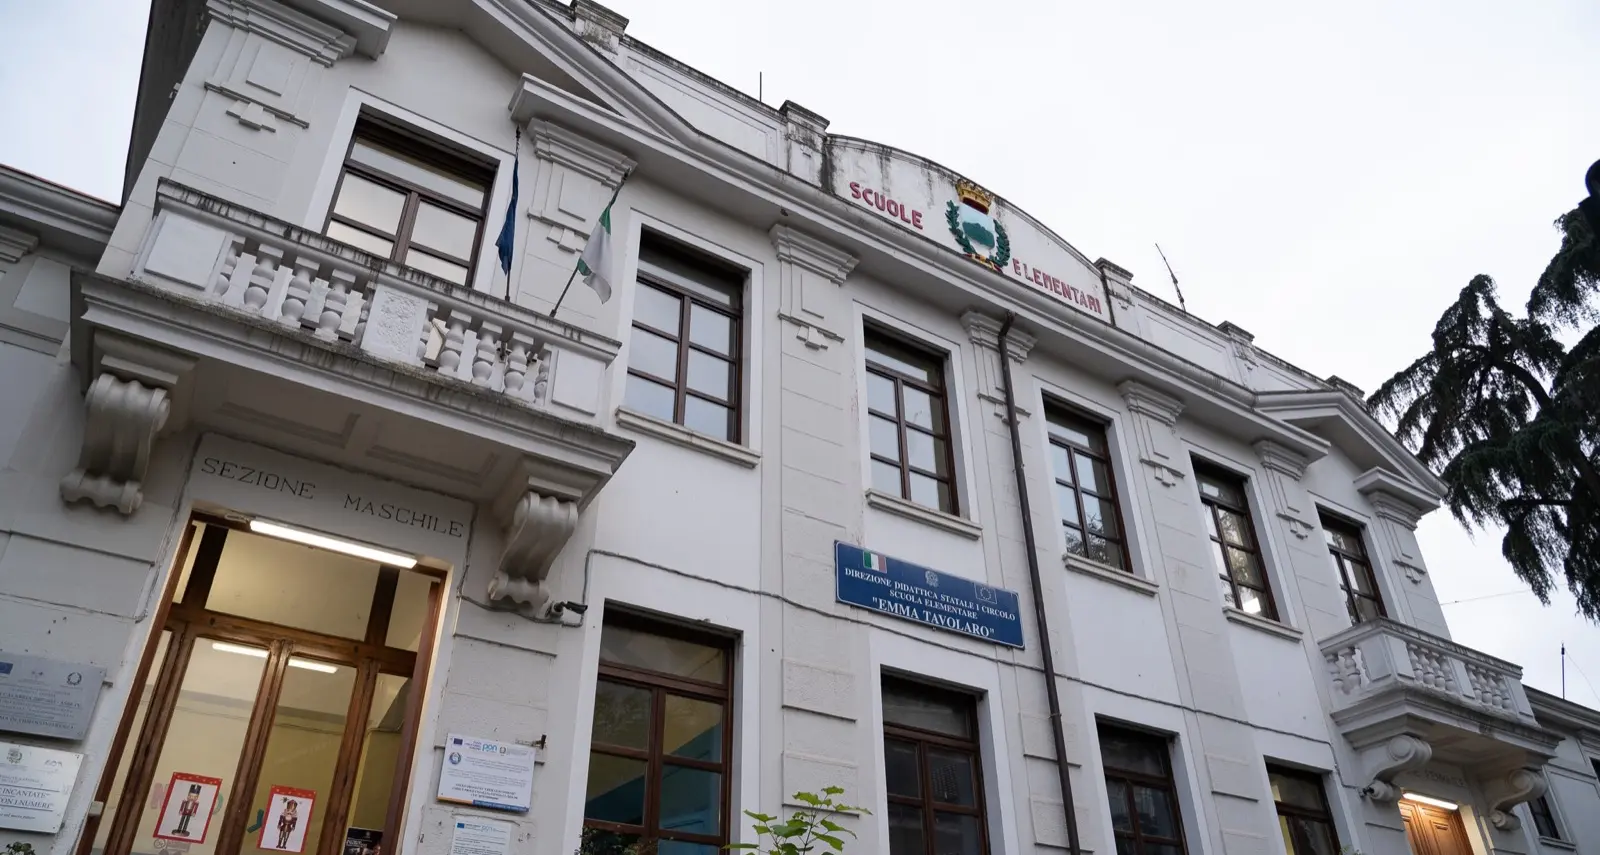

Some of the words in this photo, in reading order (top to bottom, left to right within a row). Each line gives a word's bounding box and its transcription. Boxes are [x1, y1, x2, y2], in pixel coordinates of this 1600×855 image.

[849, 181, 924, 230] SCUOLE
[1012, 257, 1103, 315] ELEMENTARI
[201, 457, 316, 500] SEZIONE
[343, 493, 464, 539] MASCHILE
[845, 567, 891, 587] DIREZIONE
[894, 581, 938, 600] DIDATTICA
[940, 593, 974, 609] STATALE
[981, 605, 1016, 622] CIRCOLO
[872, 597, 919, 619] "EMMA
[923, 611, 995, 637] TAVOLARO"
[889, 589, 923, 605] SCUOLA
[924, 599, 978, 620] ELEMENTARE
